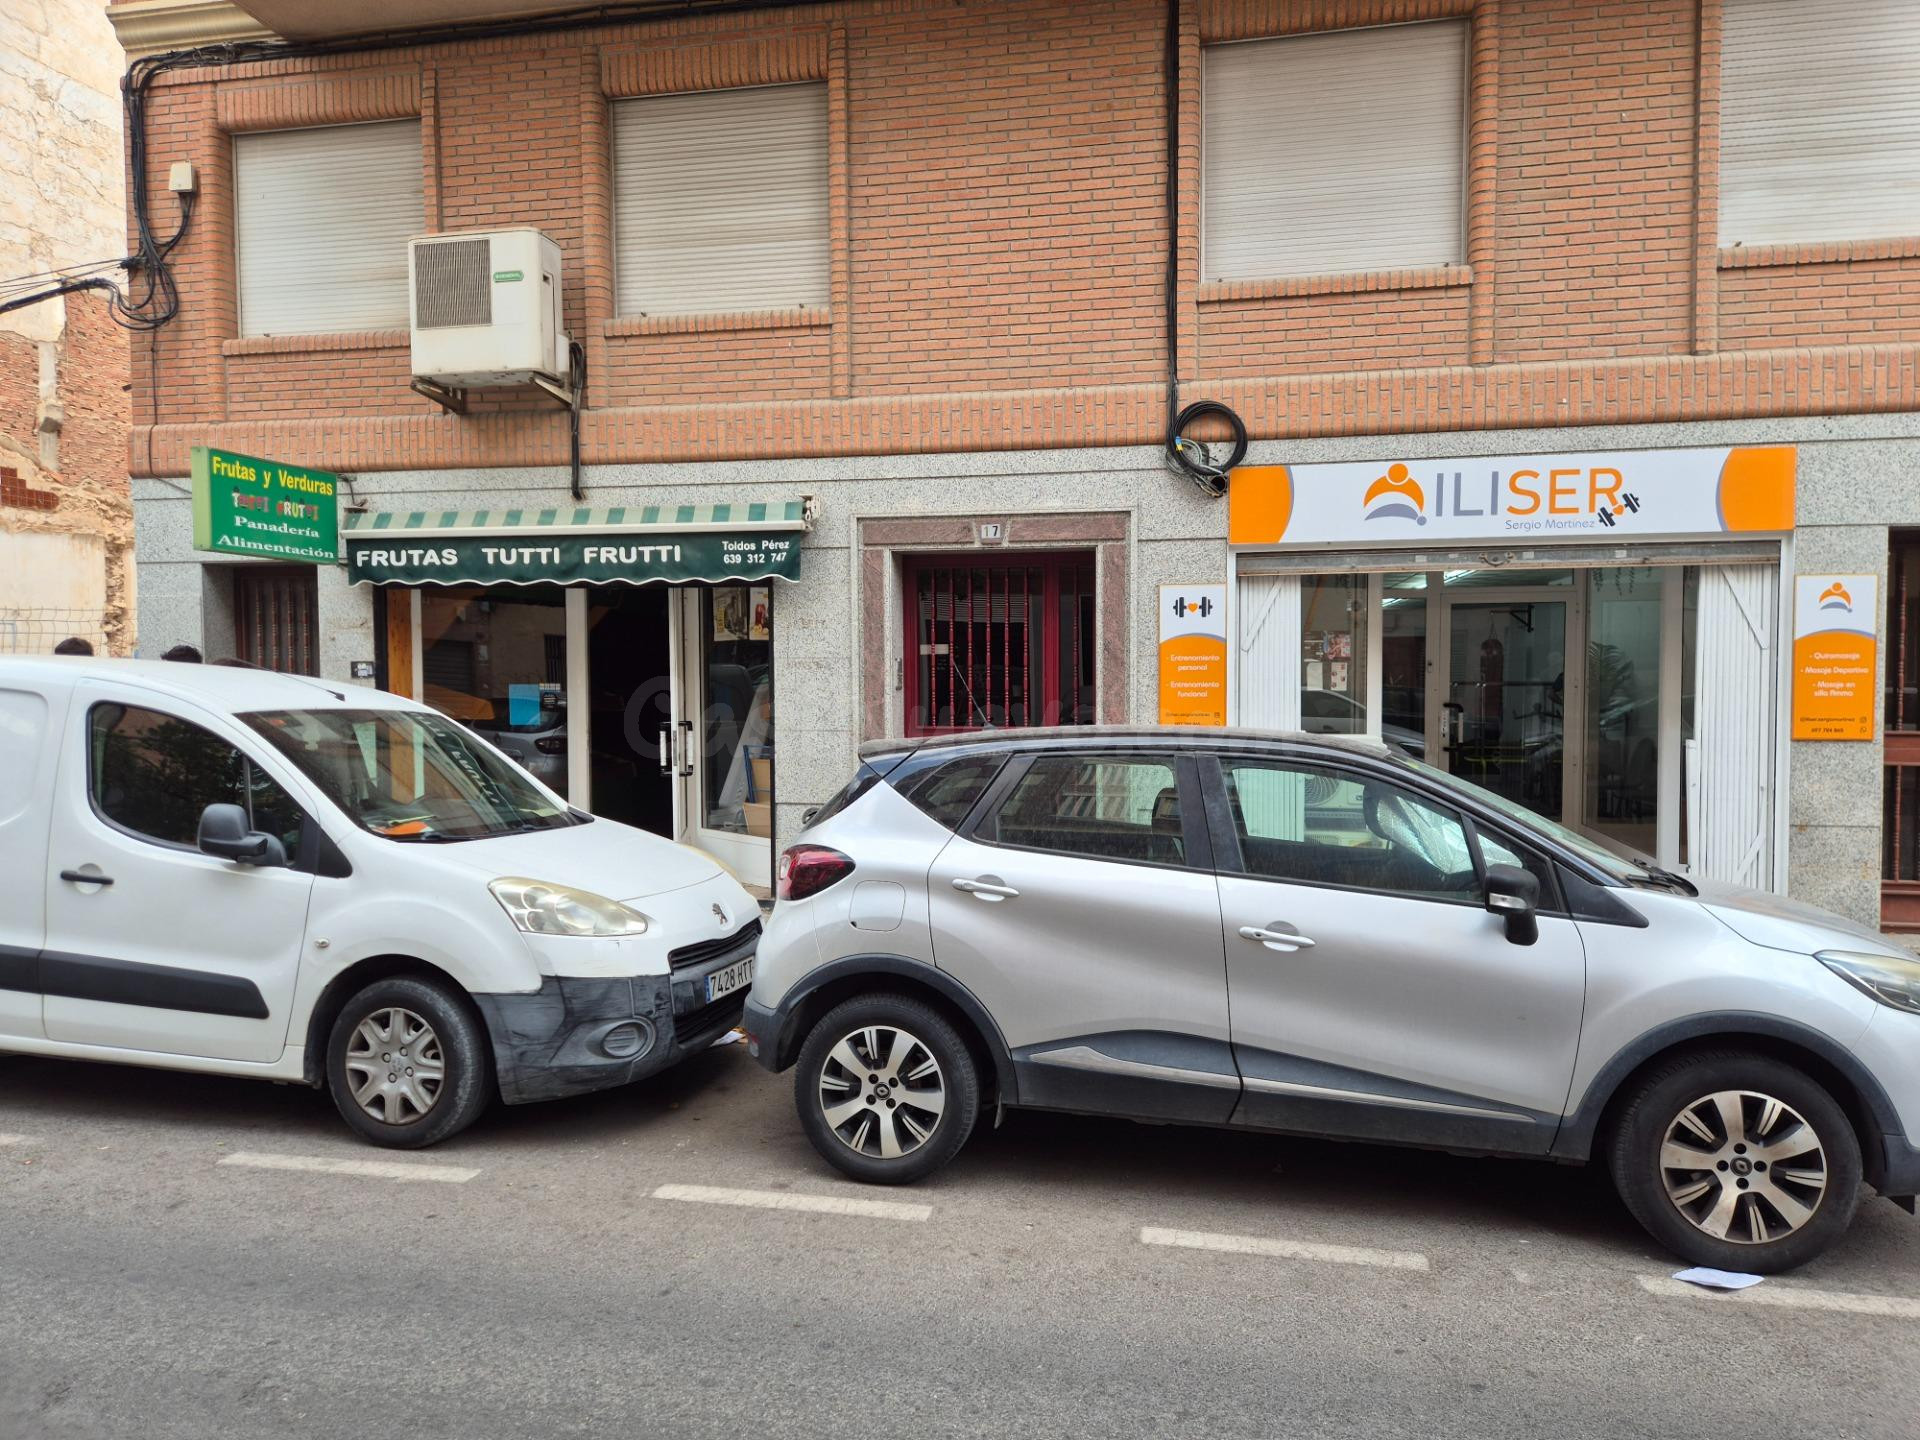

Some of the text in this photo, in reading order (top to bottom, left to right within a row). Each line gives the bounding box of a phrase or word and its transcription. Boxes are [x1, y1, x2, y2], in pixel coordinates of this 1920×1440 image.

[212, 454, 333, 496] Frutas y Verduras
[1435, 466, 1623, 518] ILISER
[234, 515, 320, 538] Panadería
[984, 525, 999, 537] 17
[1504, 518, 1541, 533] Sergio
[217, 534, 335, 559] Alimentación
[356, 544, 681, 568] FRUTAS TUTTI FRUTTI
[722, 538, 790, 552] Toldos Pérez
[723, 551, 787, 565] 639 312 747
[710, 959, 753, 997] 7428 HTT
